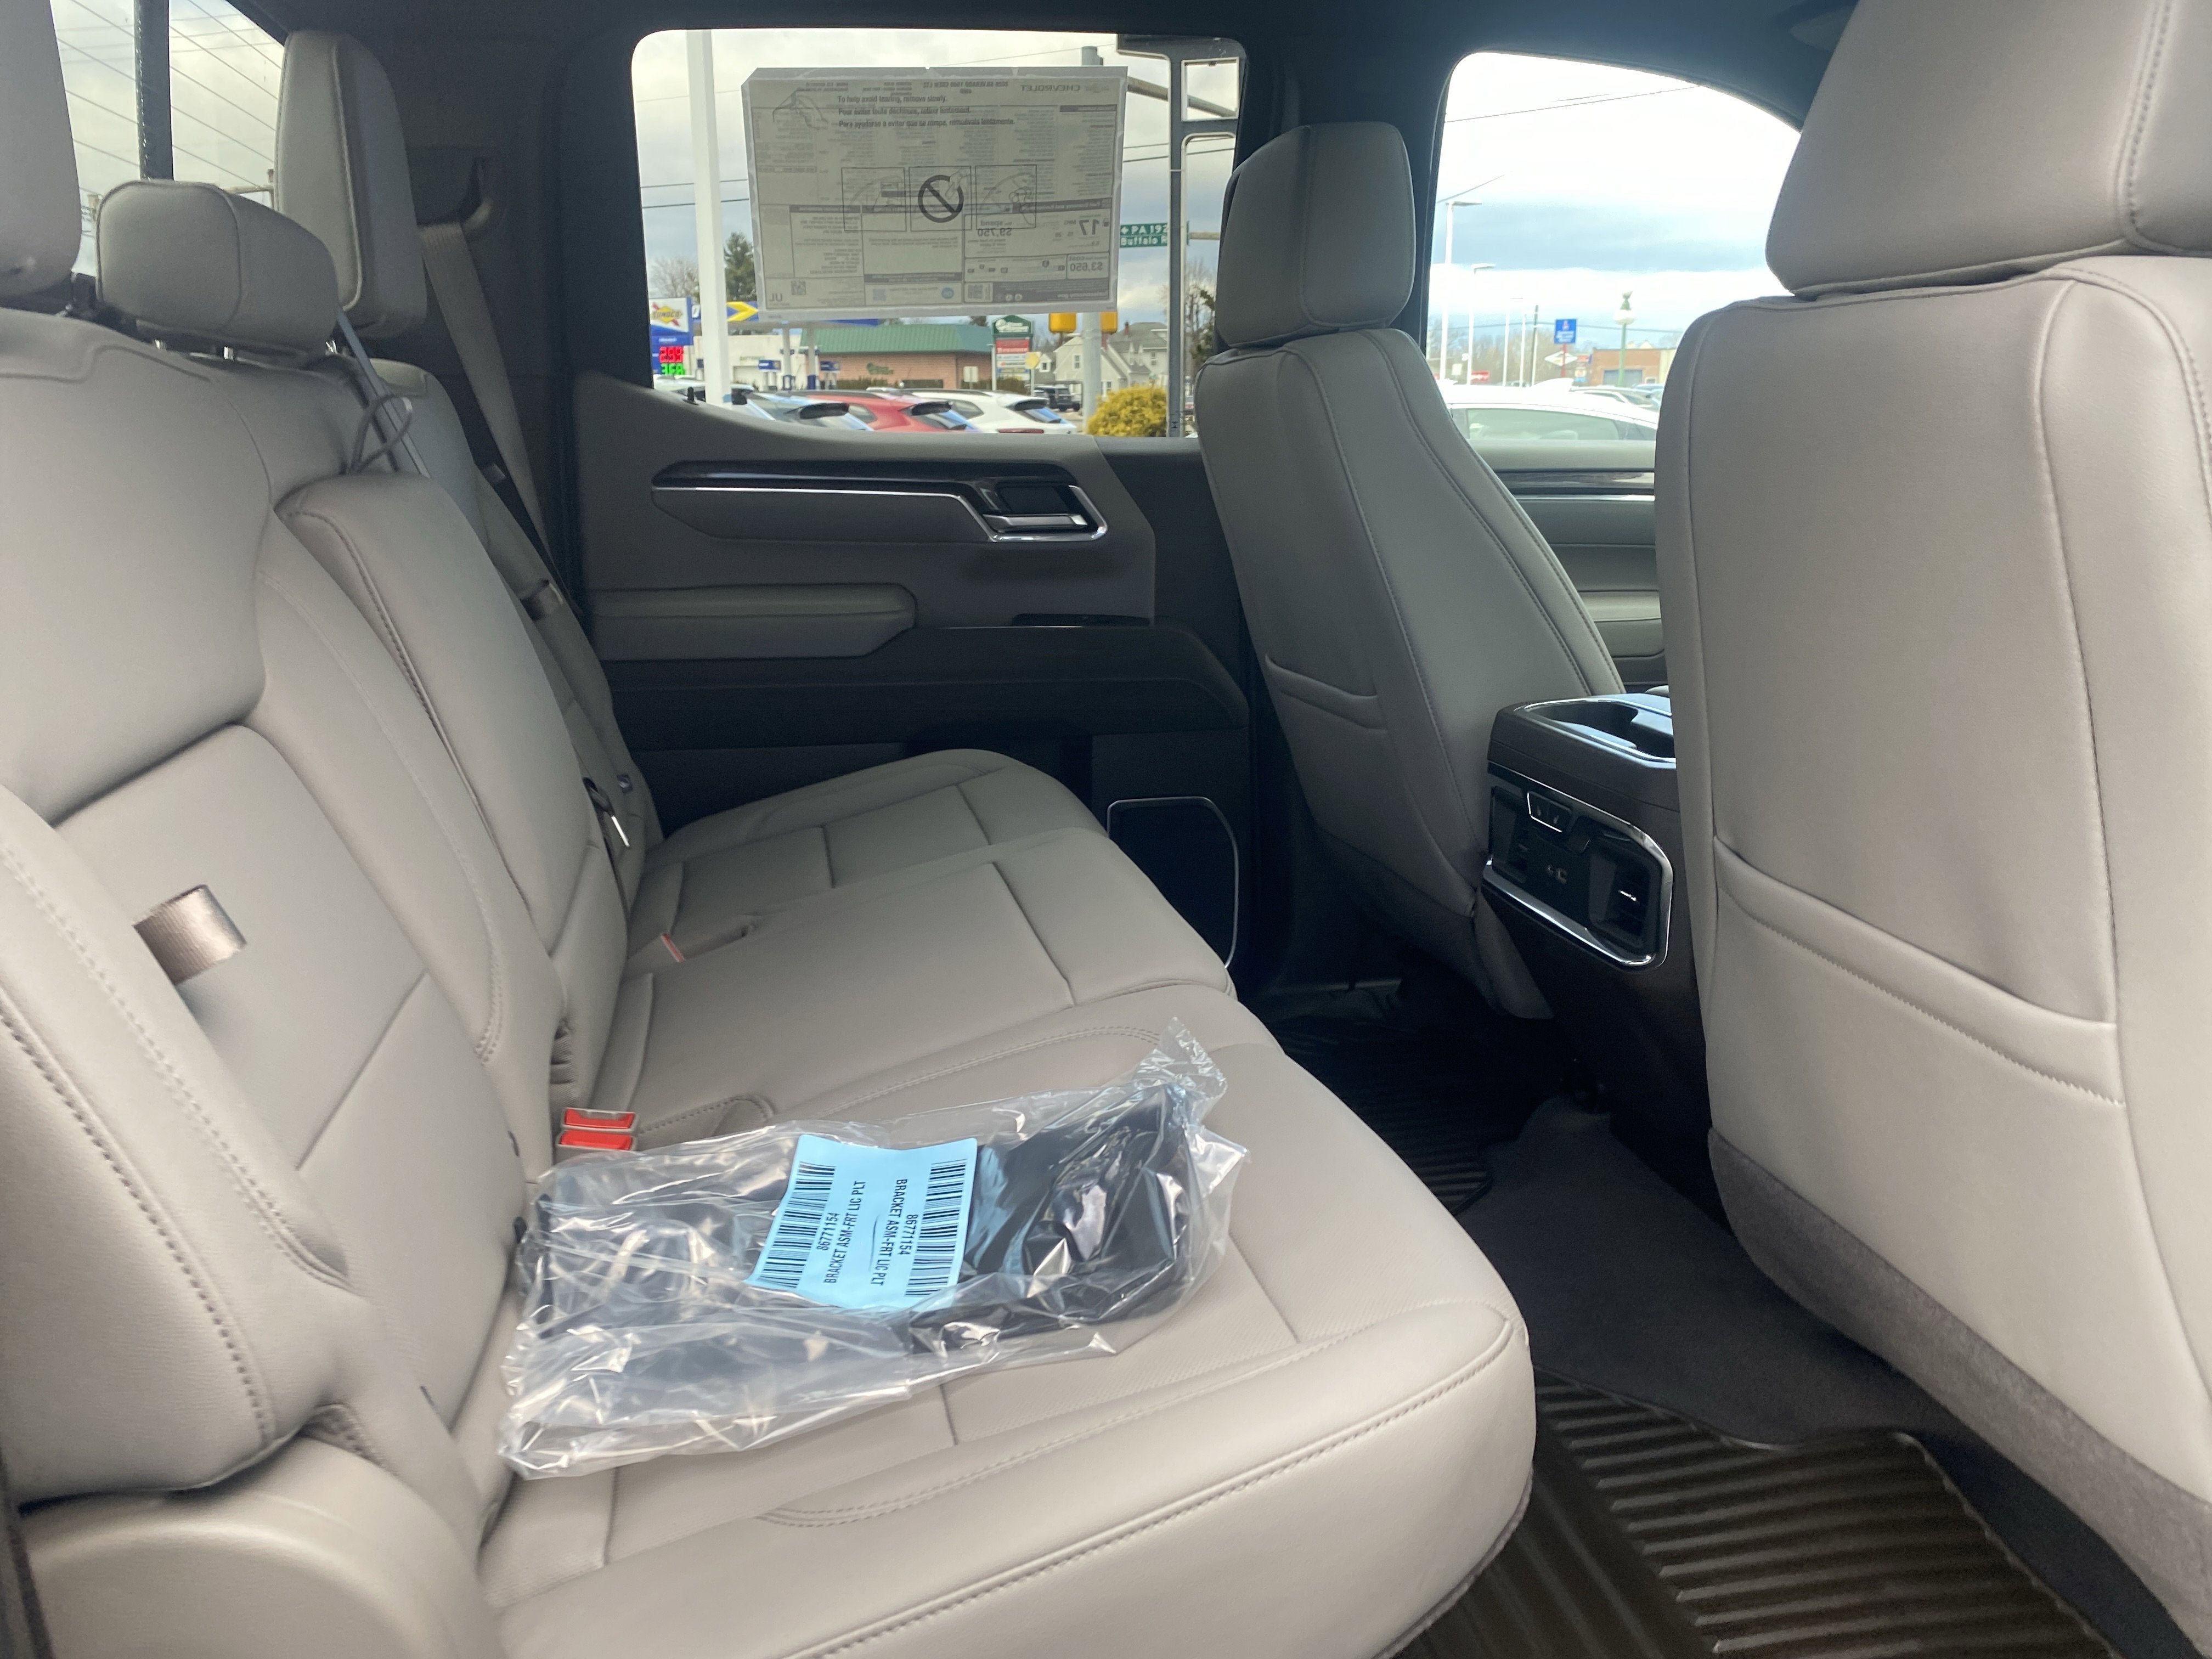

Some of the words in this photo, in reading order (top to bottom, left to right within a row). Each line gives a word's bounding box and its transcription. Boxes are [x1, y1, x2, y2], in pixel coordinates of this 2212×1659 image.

[927, 95, 947, 103] slowly.
[1131, 225, 1147, 234] PA
[1120, 235, 1158, 246] Buffalo
[651, 310, 684, 320] SUNOCO
[851, 1181, 866, 1195] PLT
[847, 1198, 862, 1210] LIC
[889, 1179, 908, 1217] BRACKET
[816, 1212, 840, 1250] 86771154
[836, 1212, 859, 1248] ASM-FRT
[898, 1214, 919, 1255] 86771154
[879, 1220, 899, 1256] ASM-FRT
[823, 1249, 848, 1283] BRACKET
[875, 1260, 890, 1271] LIC
[871, 1273, 886, 1286] PLT
